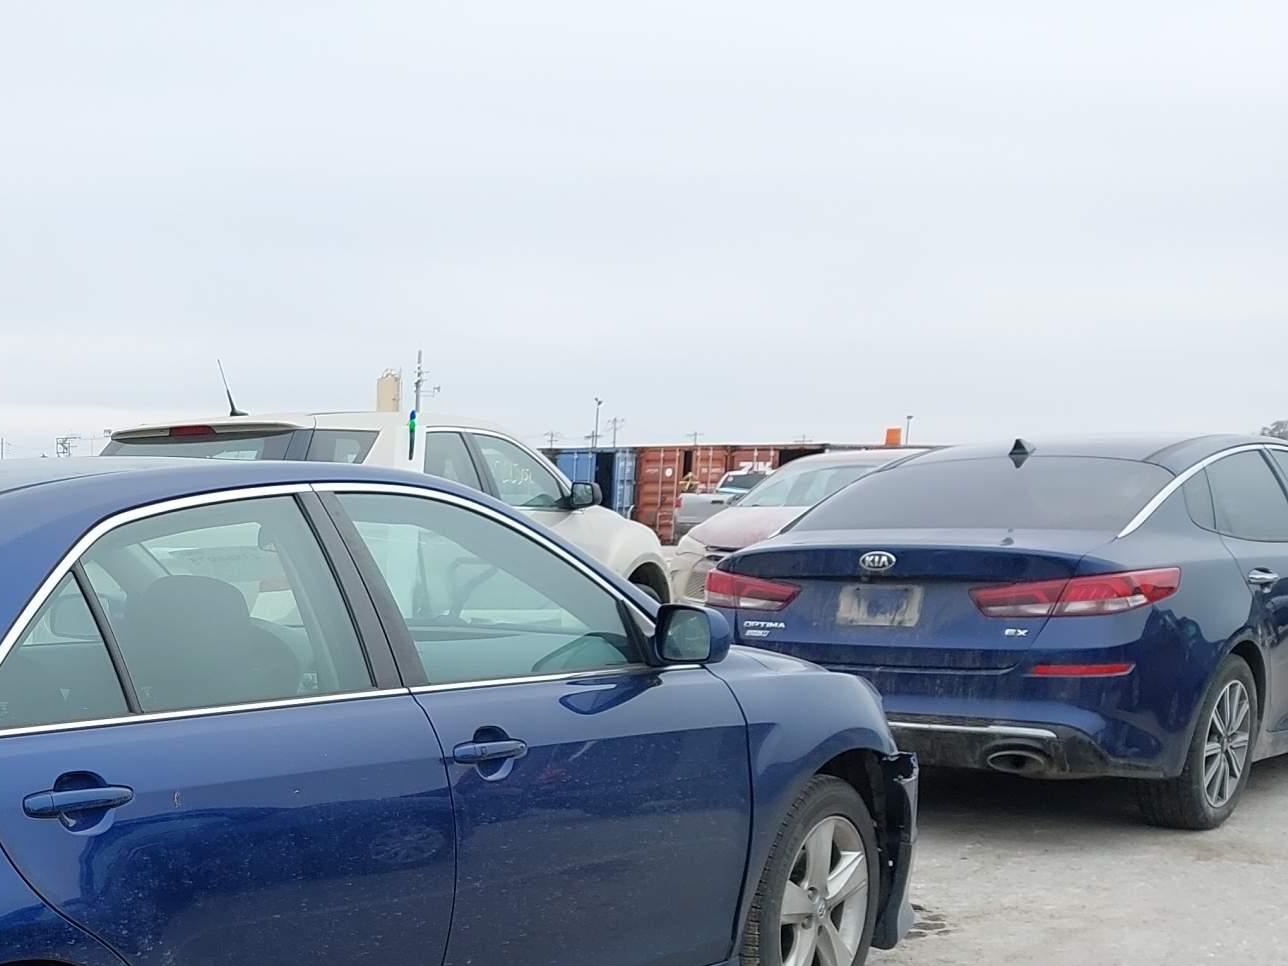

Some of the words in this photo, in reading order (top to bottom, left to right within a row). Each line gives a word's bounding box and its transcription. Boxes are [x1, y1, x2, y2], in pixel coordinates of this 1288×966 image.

[864, 555, 889, 567] KIA
[743, 620, 785, 628] OPTIMA
[1004, 628, 1029, 637] EX
